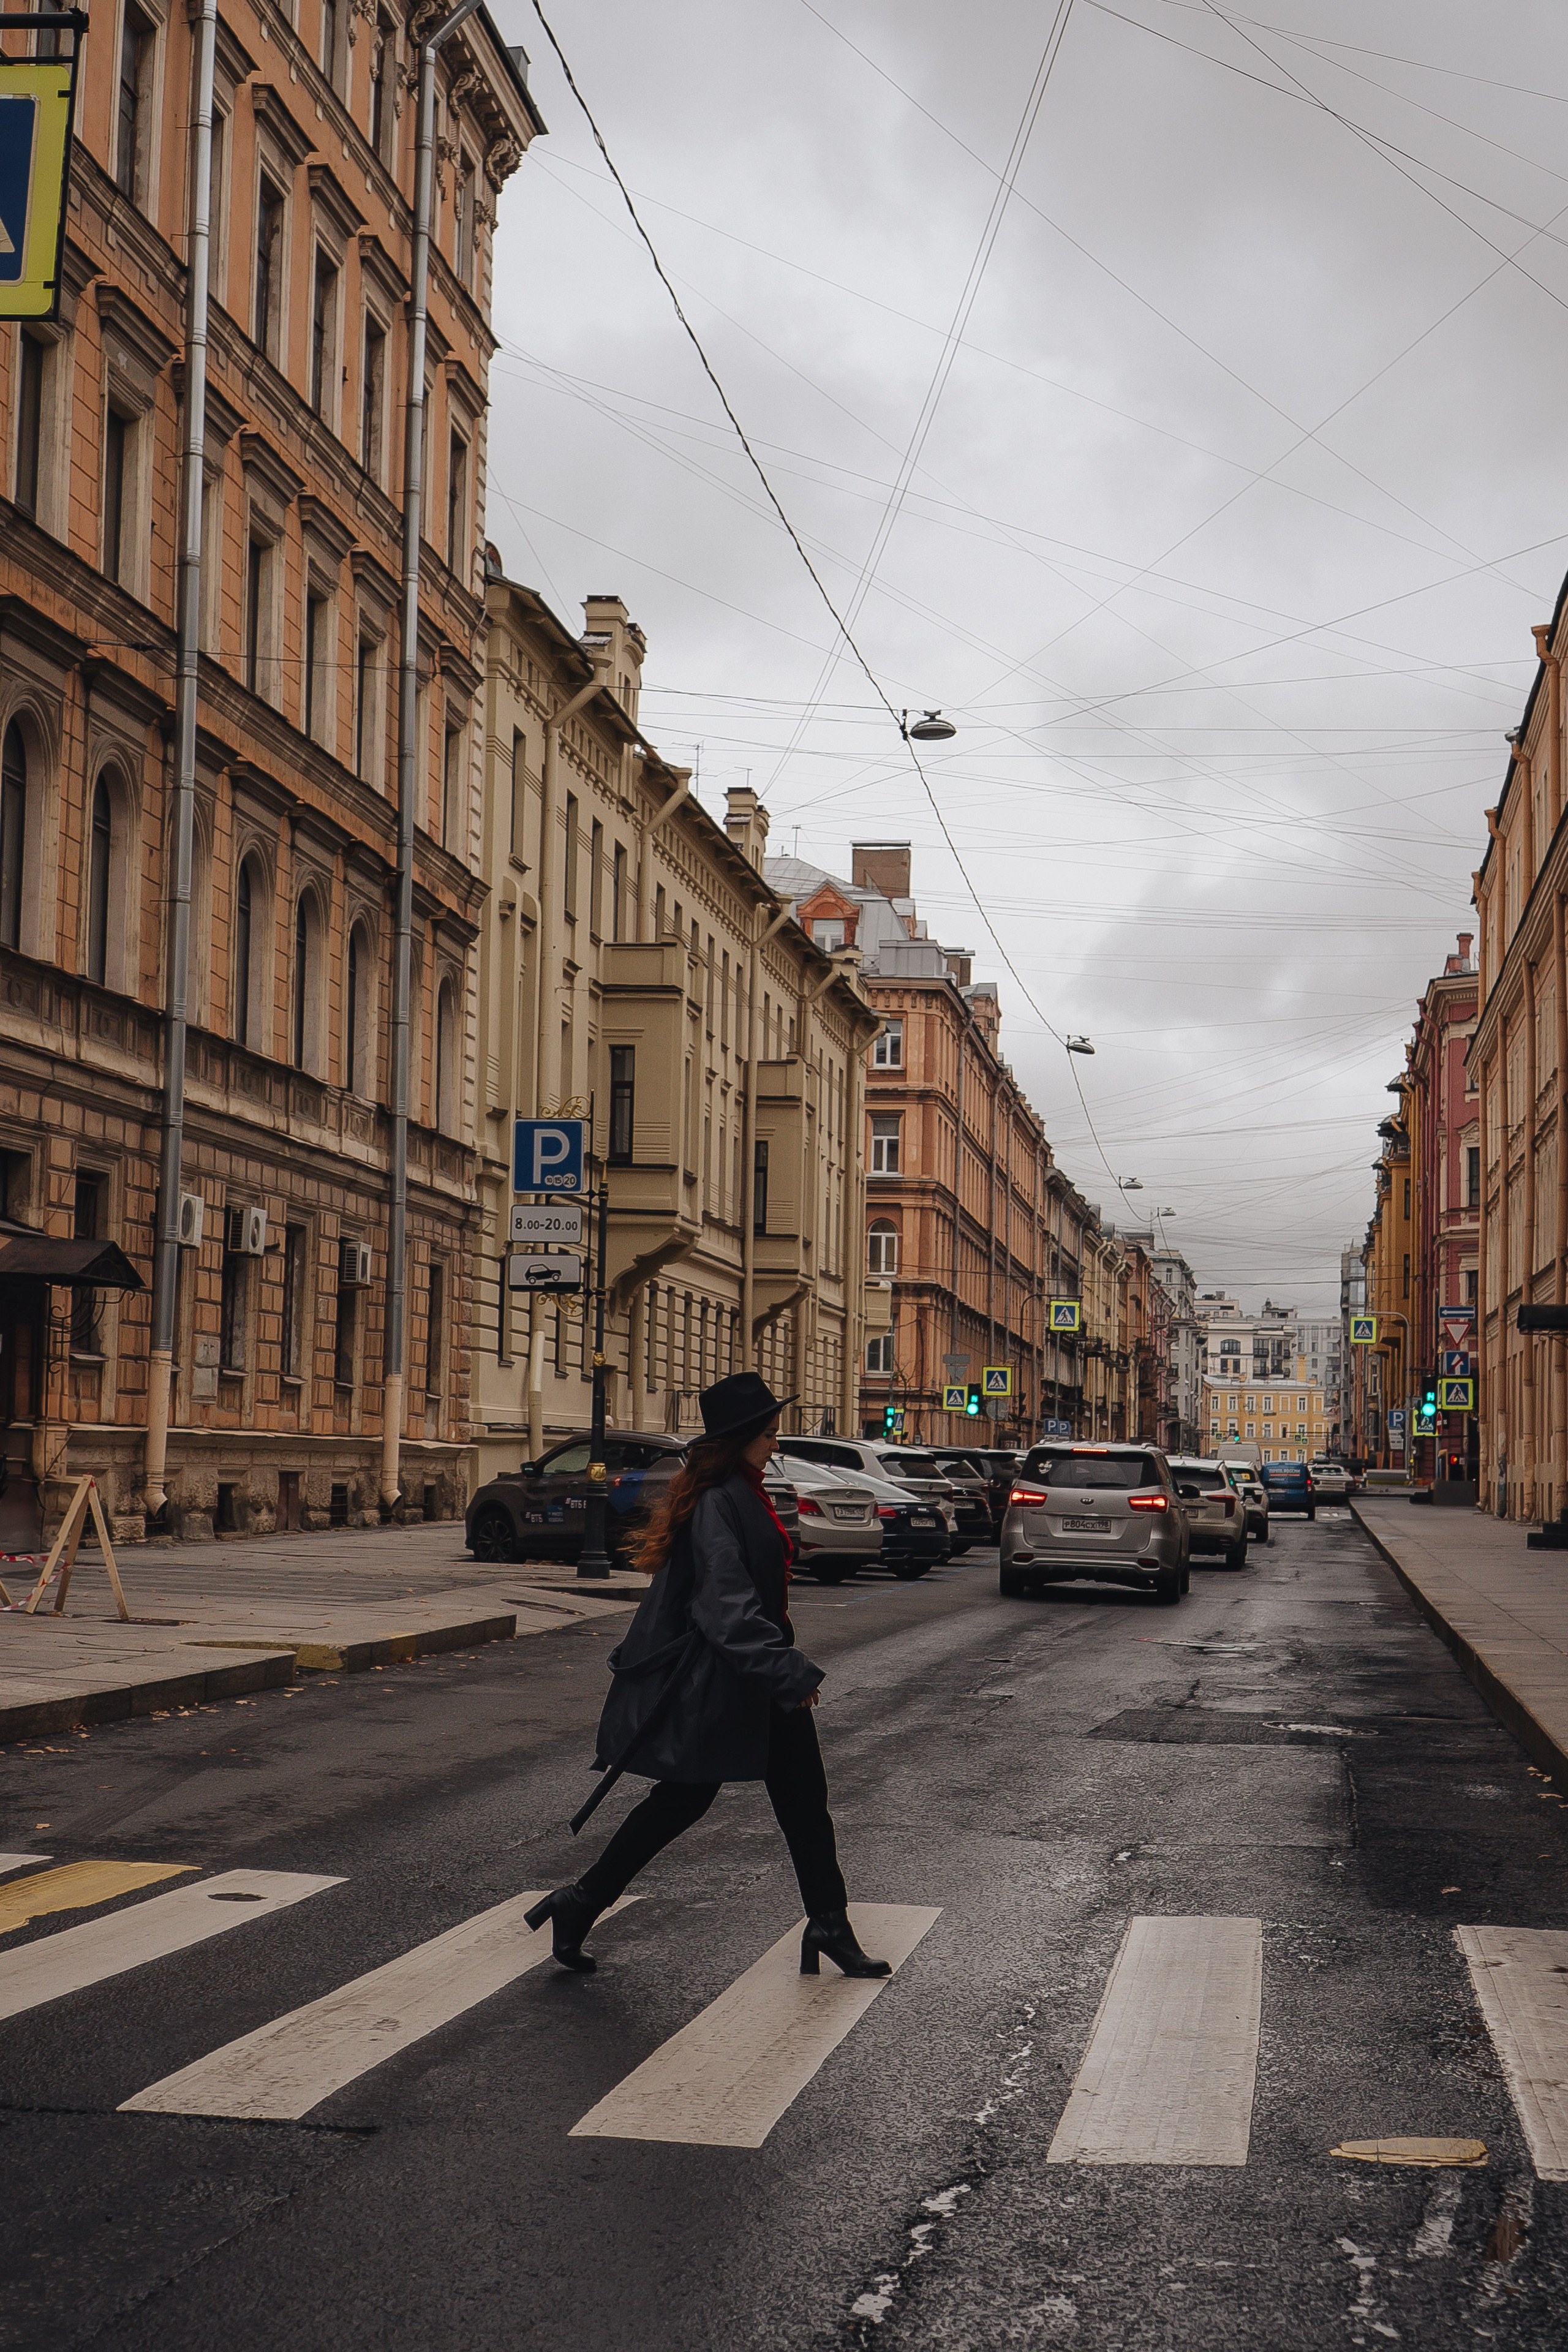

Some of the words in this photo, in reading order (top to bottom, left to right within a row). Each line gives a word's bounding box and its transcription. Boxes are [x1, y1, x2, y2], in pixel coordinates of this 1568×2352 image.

[533, 1129, 570, 1184] P
[564, 1176, 576, 1185] 20
[514, 1217, 578, 1231] 8.00-20.00
[1393, 1412, 1403, 1426] P
[1048, 1420, 1056, 1431] P
[1060, 1423, 1067, 1434] P
